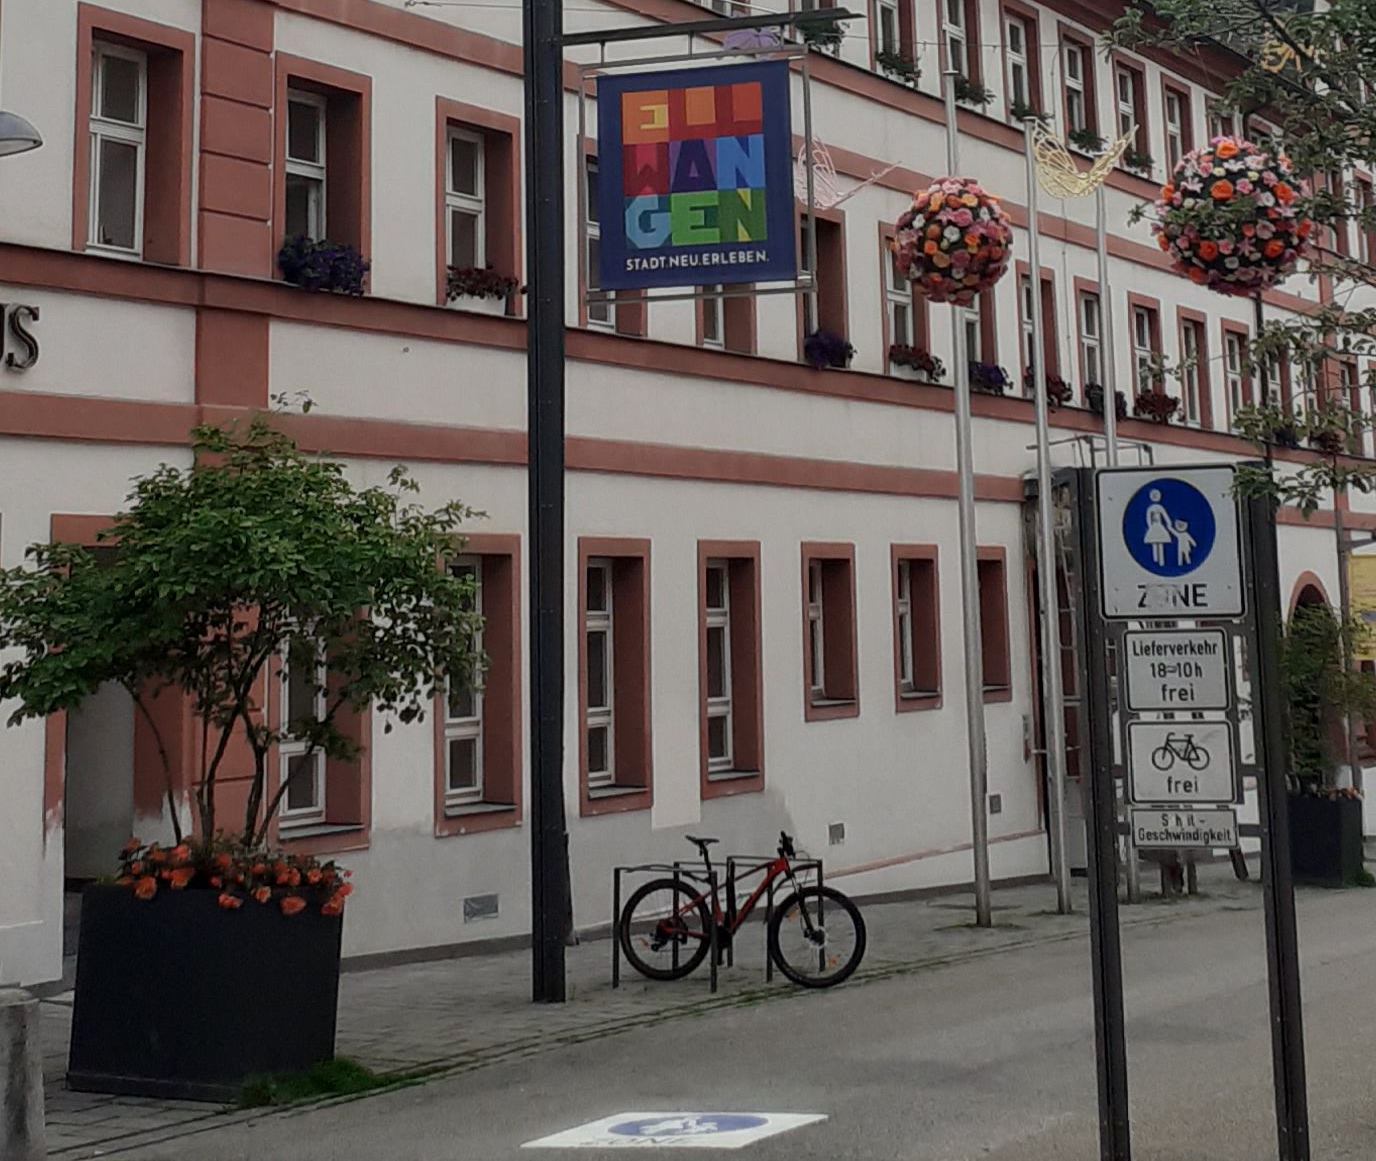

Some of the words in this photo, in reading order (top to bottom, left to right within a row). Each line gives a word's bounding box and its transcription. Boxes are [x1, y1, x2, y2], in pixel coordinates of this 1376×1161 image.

[625, 187, 768, 249] GEN
[1137, 583, 1209, 608] ZNE
[1132, 640, 1217, 656] Lieferverkehr
[1161, 683, 1195, 701] frei
[1167, 776, 1198, 793] frei
[1138, 828, 1232, 845] Geschwindigkeit
